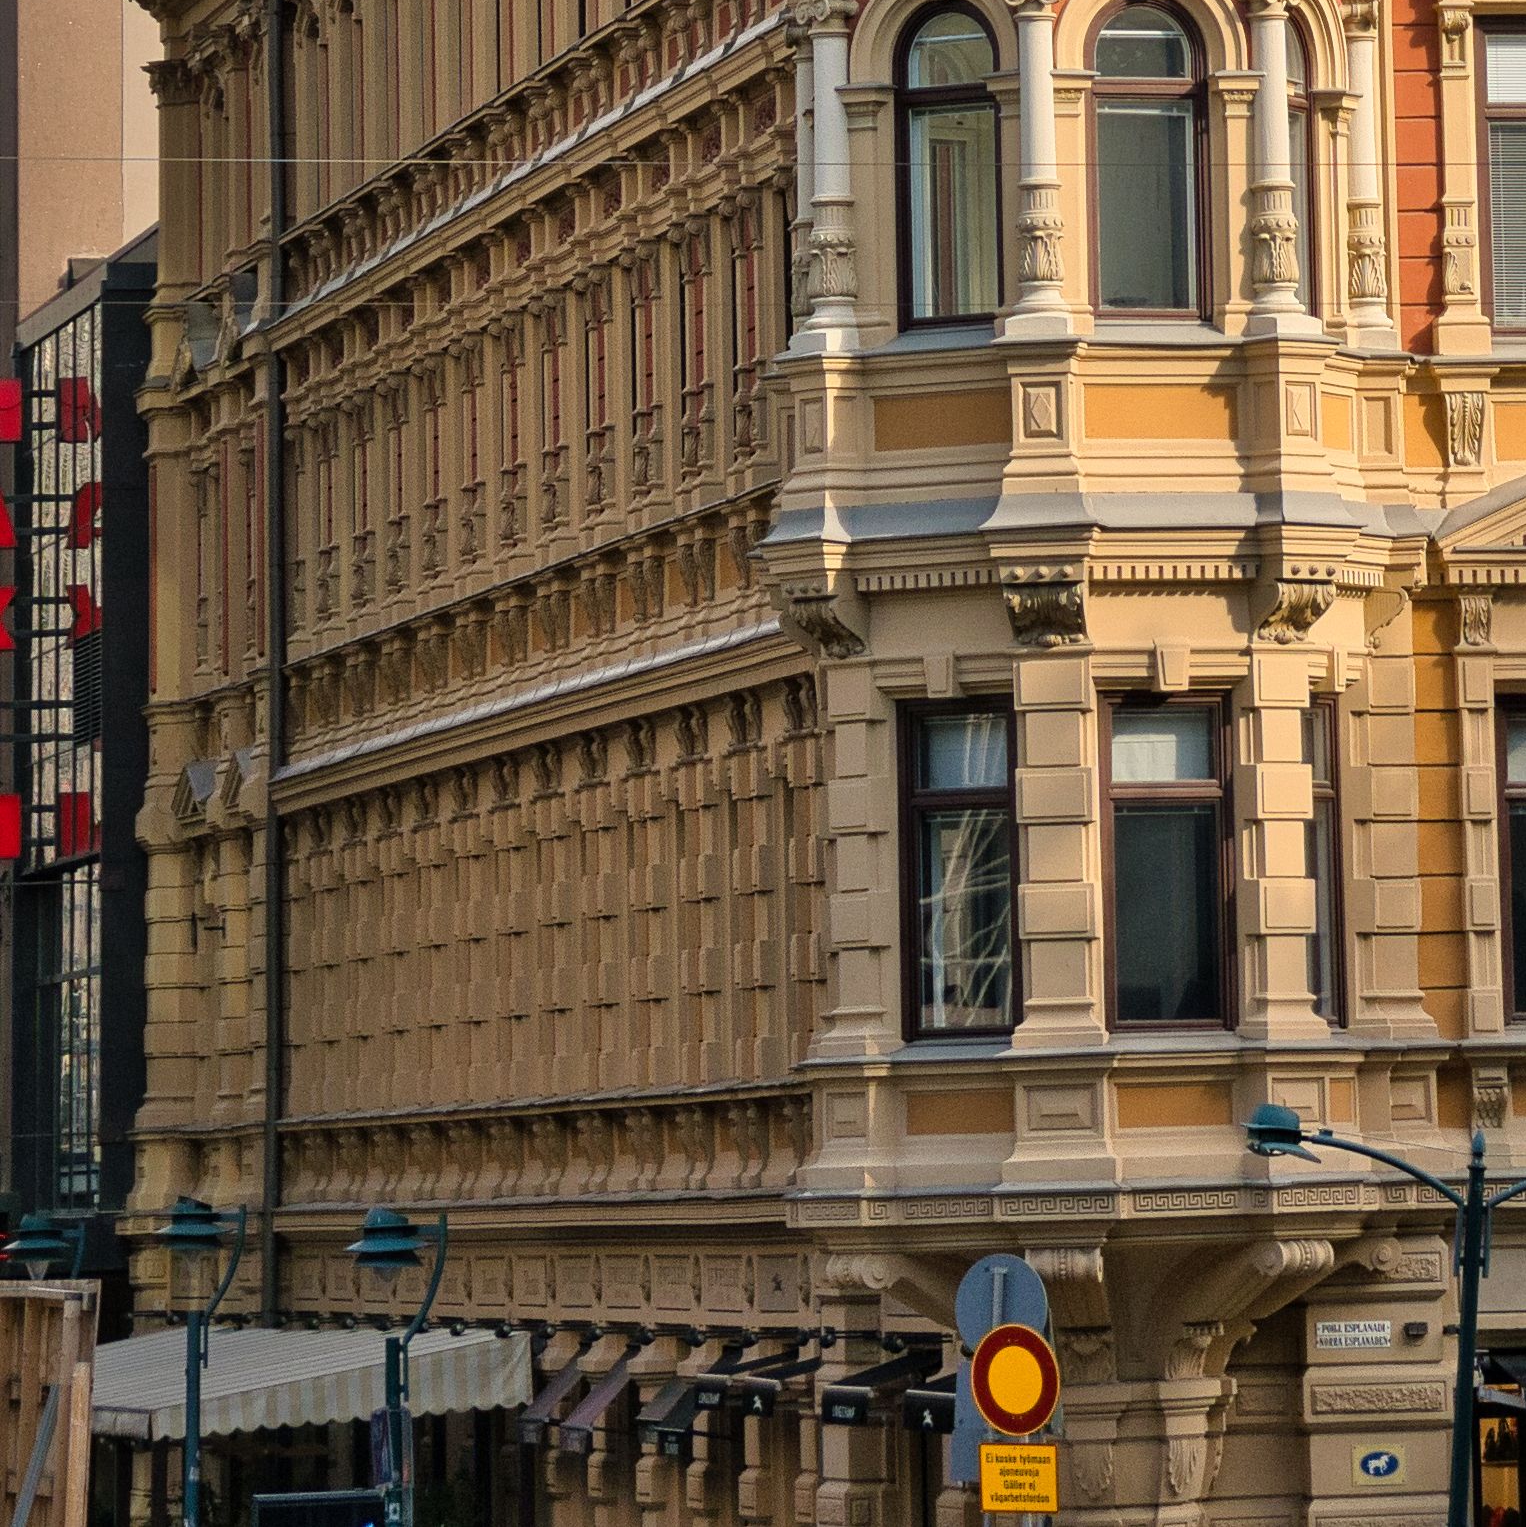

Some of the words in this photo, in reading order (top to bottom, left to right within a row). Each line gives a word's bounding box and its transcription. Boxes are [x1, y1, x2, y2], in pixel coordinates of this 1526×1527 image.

[1319, 1336, 1343, 1347] NORRA
[1344, 1336, 1388, 1347] ESPLANADEN
[985, 1453, 993, 1463] Ei
[995, 1454, 1016, 1464] koske
[1003, 1479, 1026, 1490] Gäller
[1029, 1479, 1036, 1491] ej
